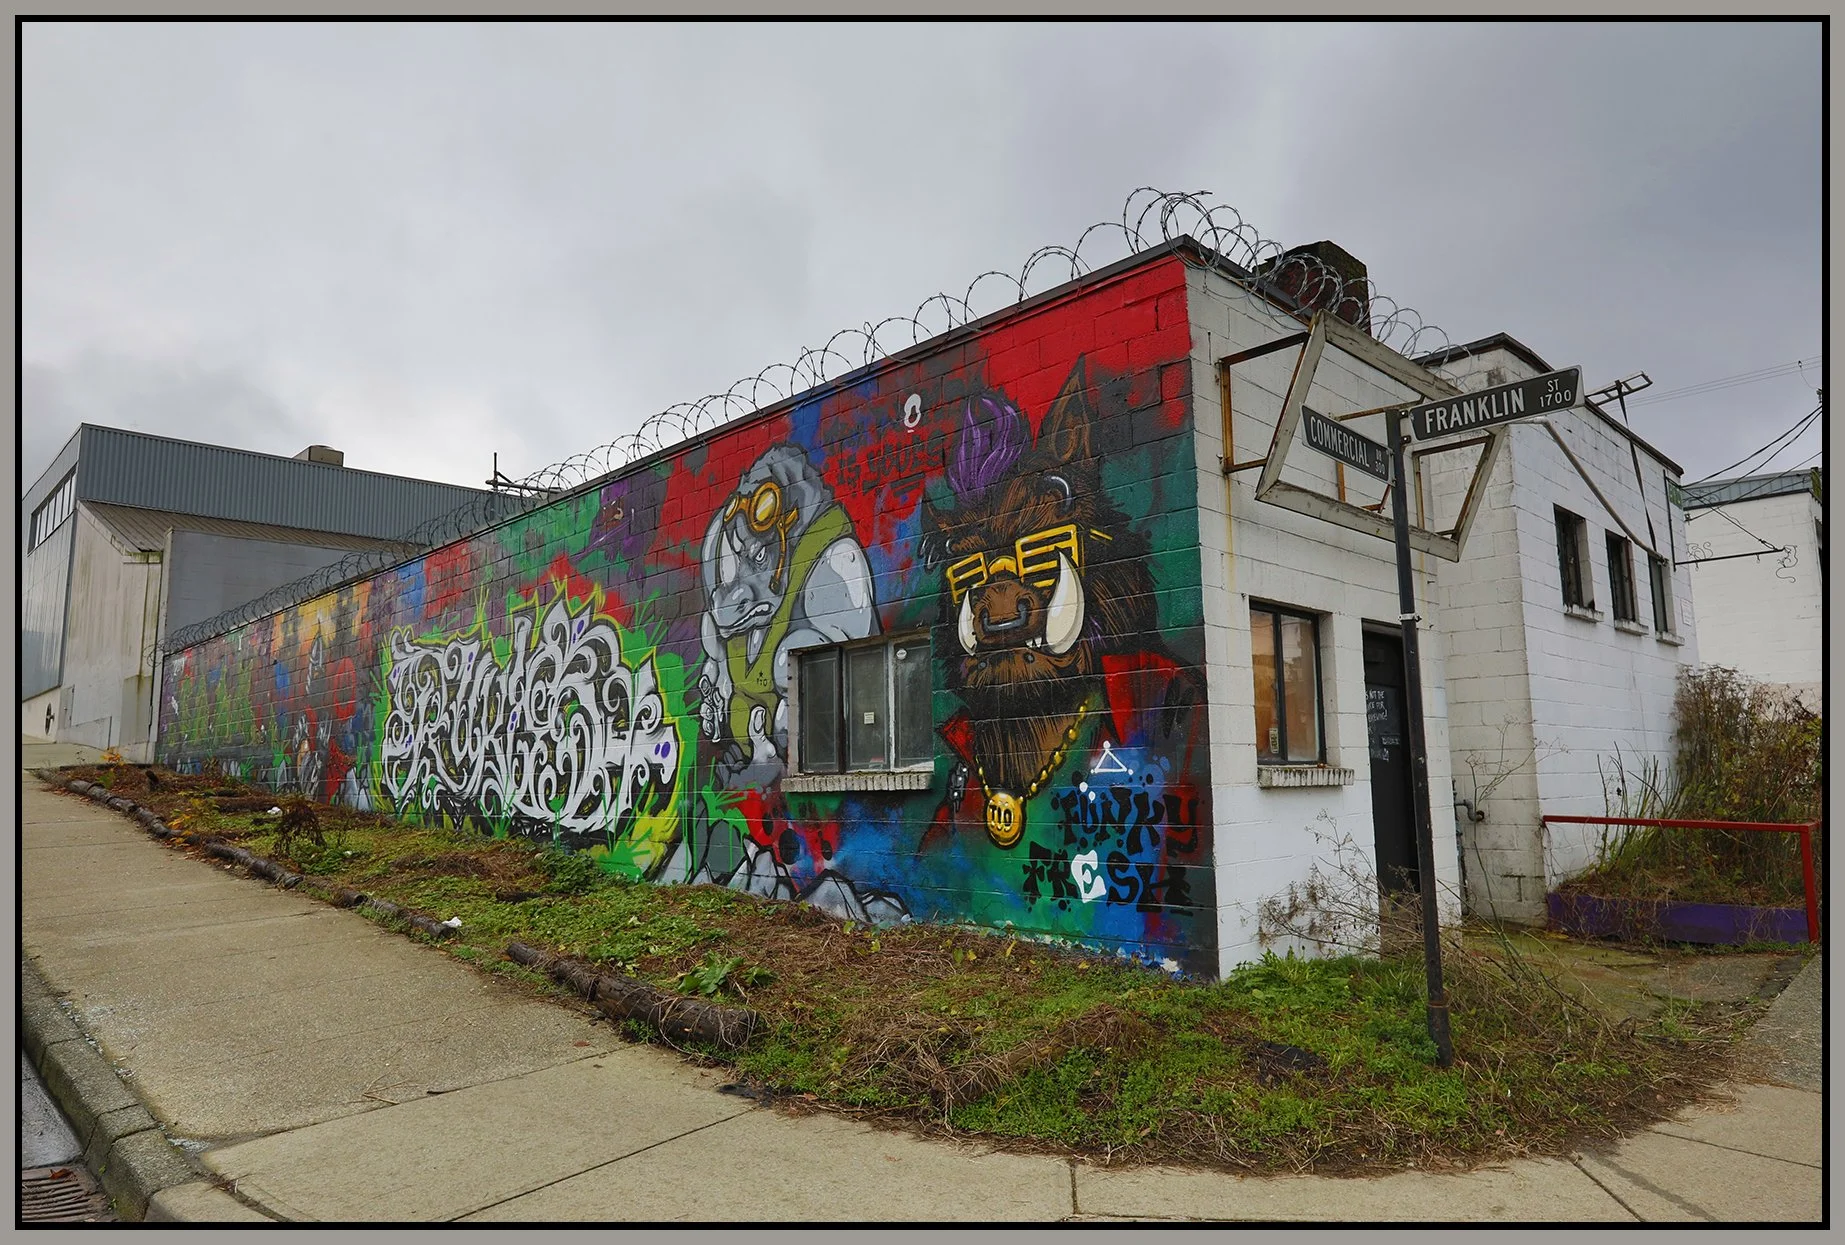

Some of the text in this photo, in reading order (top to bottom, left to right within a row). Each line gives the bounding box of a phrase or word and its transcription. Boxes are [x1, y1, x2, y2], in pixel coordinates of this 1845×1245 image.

[1539, 389, 1573, 408] 1700
[1547, 378, 1560, 393] ST
[1425, 387, 1526, 435] FRANKLIN
[1310, 416, 1370, 468] COMMERCIAL
[1375, 460, 1386, 475] 300
[1053, 787, 1198, 854] FUNKY
[1022, 841, 1194, 913] FRESH
